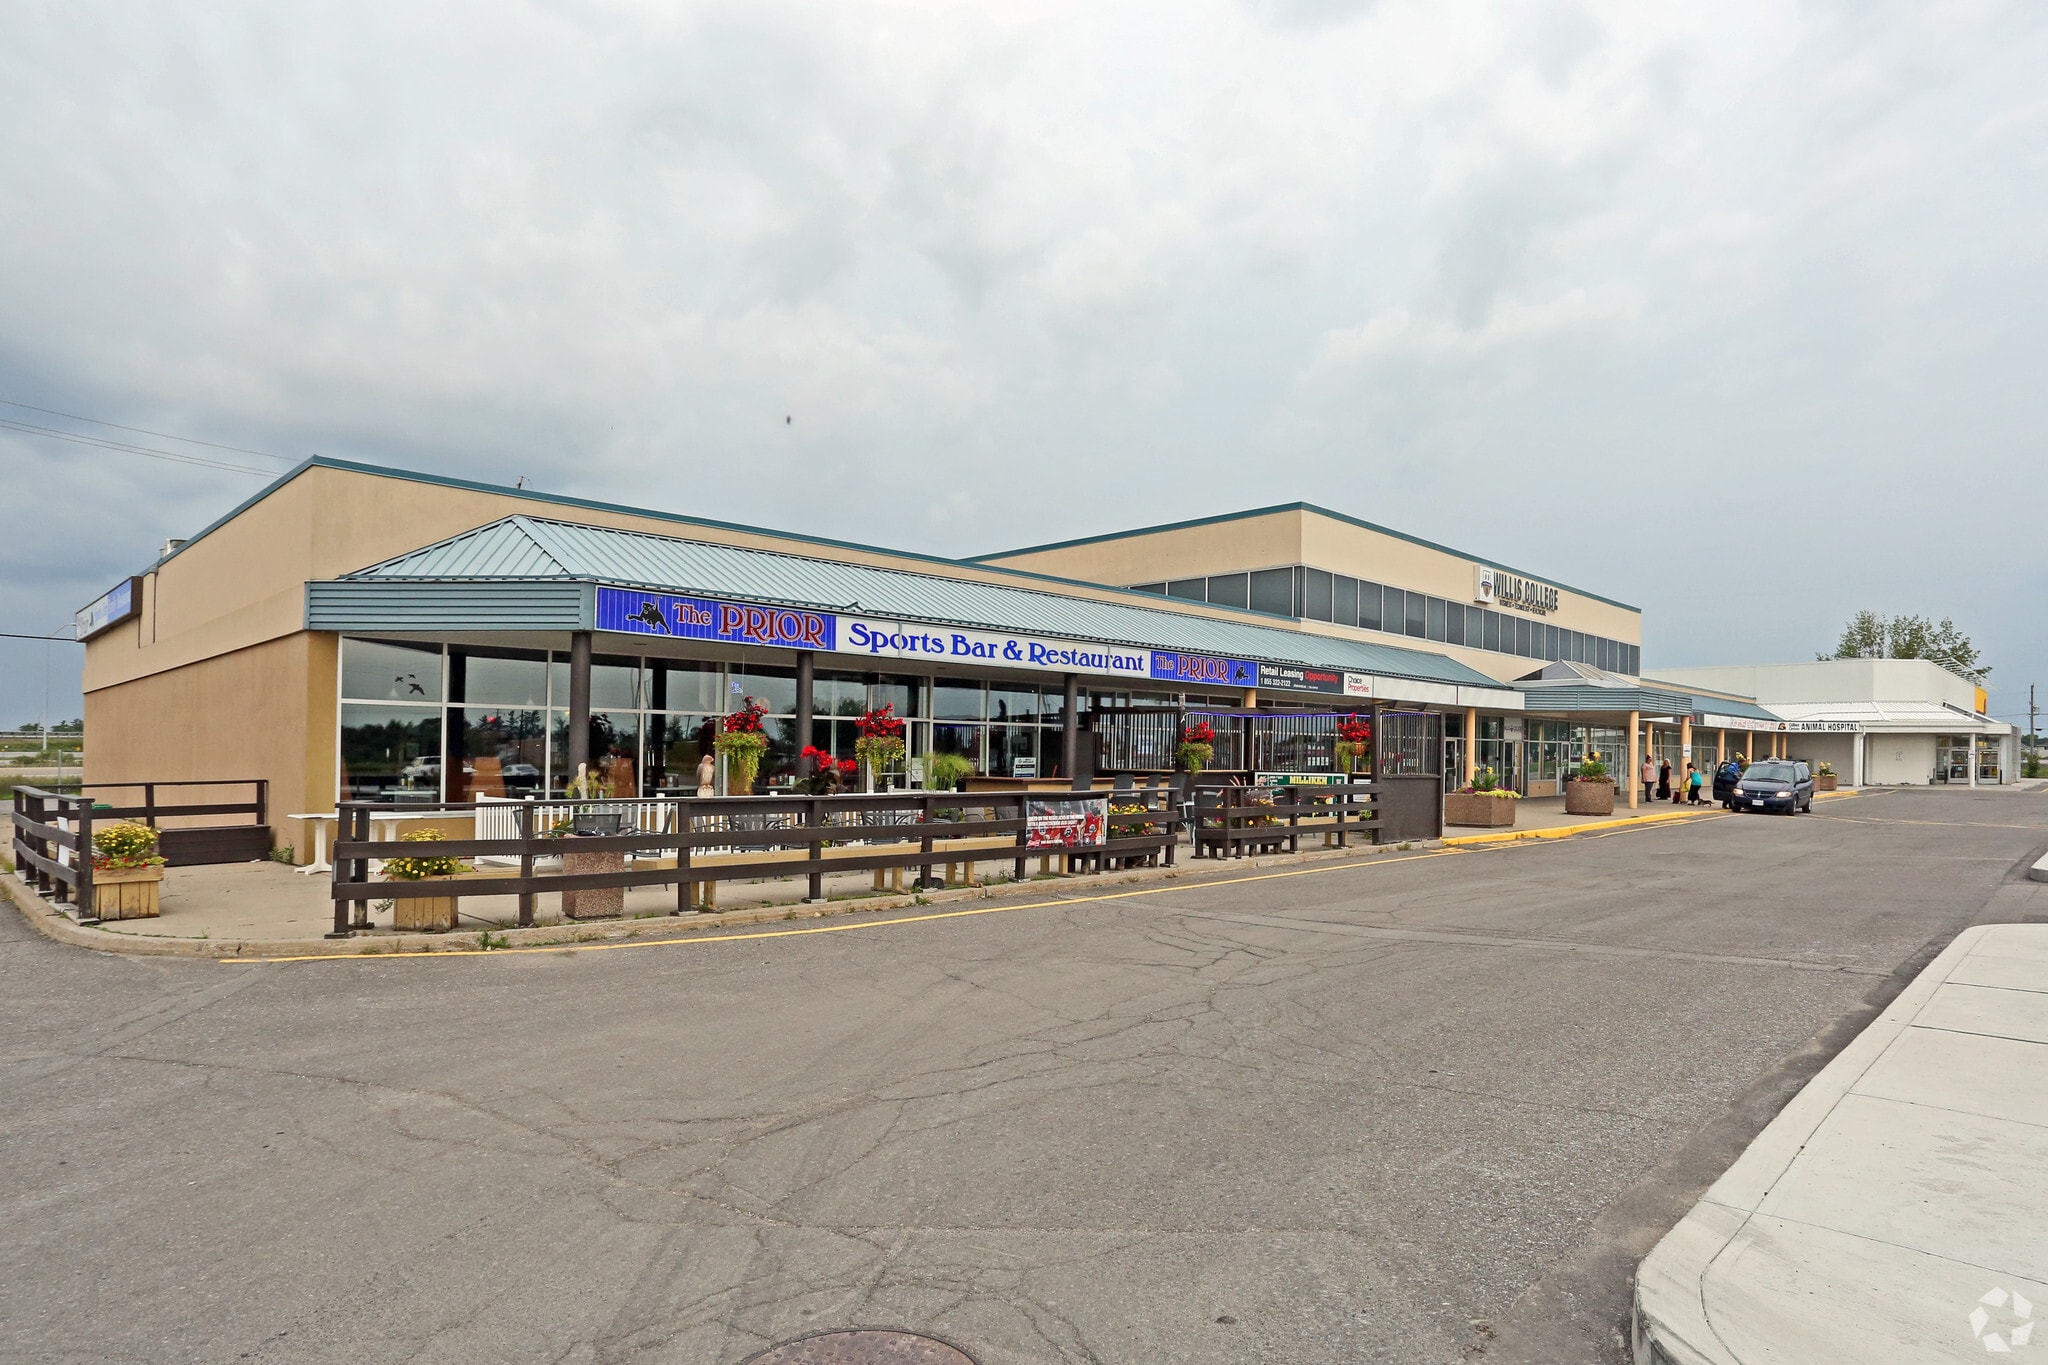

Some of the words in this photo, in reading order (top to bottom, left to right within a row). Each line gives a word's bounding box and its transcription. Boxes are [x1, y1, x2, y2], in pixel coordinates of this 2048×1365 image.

[1493, 571, 1522, 601] WILLIS
[1525, 581, 1558, 611] COLLEGE
[673, 602, 712, 625] The
[718, 604, 826, 647] PRIOR
[848, 622, 945, 654] Sports
[951, 634, 998, 658] Bar
[1003, 640, 1023, 661] &
[1028, 642, 1144, 672] Restaurant
[1155, 655, 1175, 670] The
[1177, 655, 1229, 683] PRIOR
[1260, 665, 1278, 677] Retail
[1280, 667, 1304, 681] Leasing
[1305, 670, 1338, 685] Opportunity
[1348, 675, 1363, 684] Choice
[1348, 683, 1370, 693] Properties
[1801, 722, 1826, 732] ANIMAL
[1827, 722, 1858, 732] HOSPITAL
[1289, 775, 1328, 785] MILLIKEN
